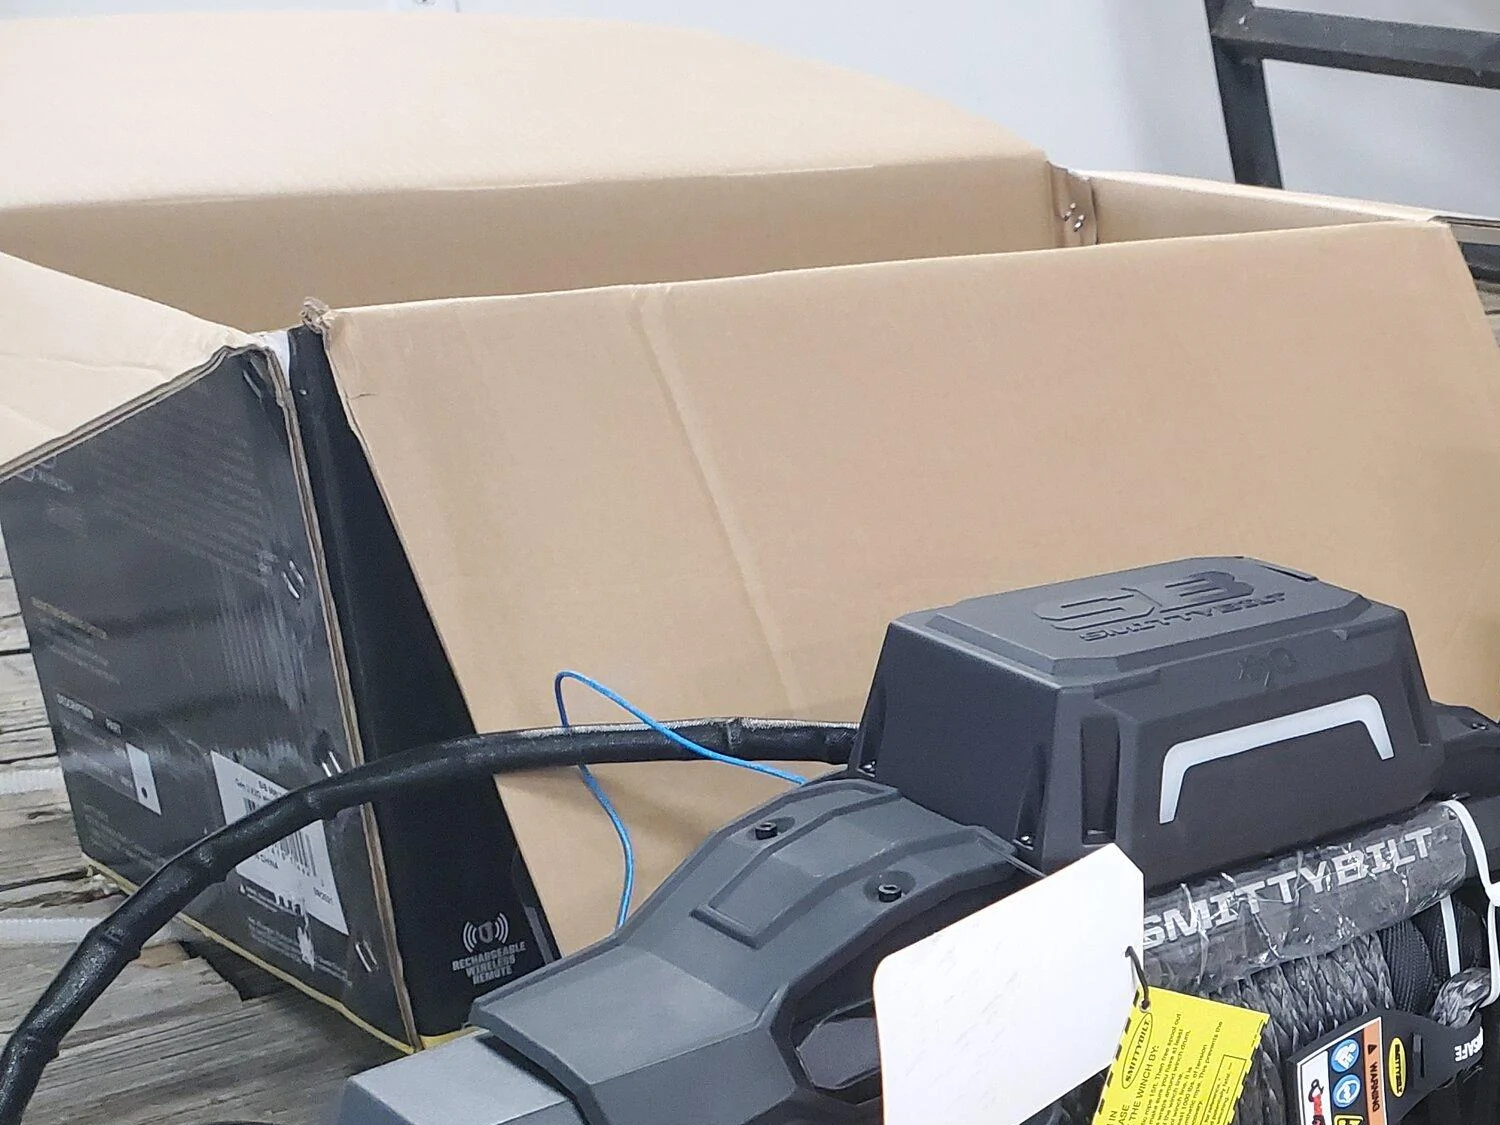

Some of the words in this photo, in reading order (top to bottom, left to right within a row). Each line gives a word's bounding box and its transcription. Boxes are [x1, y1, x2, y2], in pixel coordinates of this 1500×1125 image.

[1080, 592, 1285, 641] SMITTYBILT
[1143, 827, 1432, 949] SMITTYBILT
[452, 941, 526, 971] RECHARGEABLE
[466, 955, 516, 977] WIRELESS
[473, 966, 513, 985] REMOTE
[1125, 1020, 1149, 1081] SMITTYBILT
[1144, 1099, 1152, 1115] rope
[1154, 1062, 1164, 1079] Then
[1161, 1047, 1169, 1060] free
[1167, 1026, 1176, 1046] spool
[1198, 1065, 1207, 1078] This
[1205, 1034, 1218, 1063] prevents
[1128, 1101, 1141, 1121] THE
[1135, 1064, 1152, 1098] WINCH
[1148, 1045, 1159, 1061] BY:
[1148, 1105, 1157, 1124] make
[1155, 1088, 1163, 1103] sure
[1164, 1055, 1174, 1072] have
[1173, 1028, 1183, 1045] least
[1157, 1099, 1167, 1120] wraps
[1164, 1073, 1175, 1097] around
[1173, 1051, 1183, 1071] winch
[1181, 1093, 1190, 1109] 1000
[1195, 1044, 1207, 1069] tension
[1368, 1061, 1380, 1112] WARNING
[1108, 1110, 1117, 1120] IN
[1163, 1109, 1171, 1120] the
[1168, 1087, 1178, 1108] winch
[1172, 1096, 1182, 1117] winch
